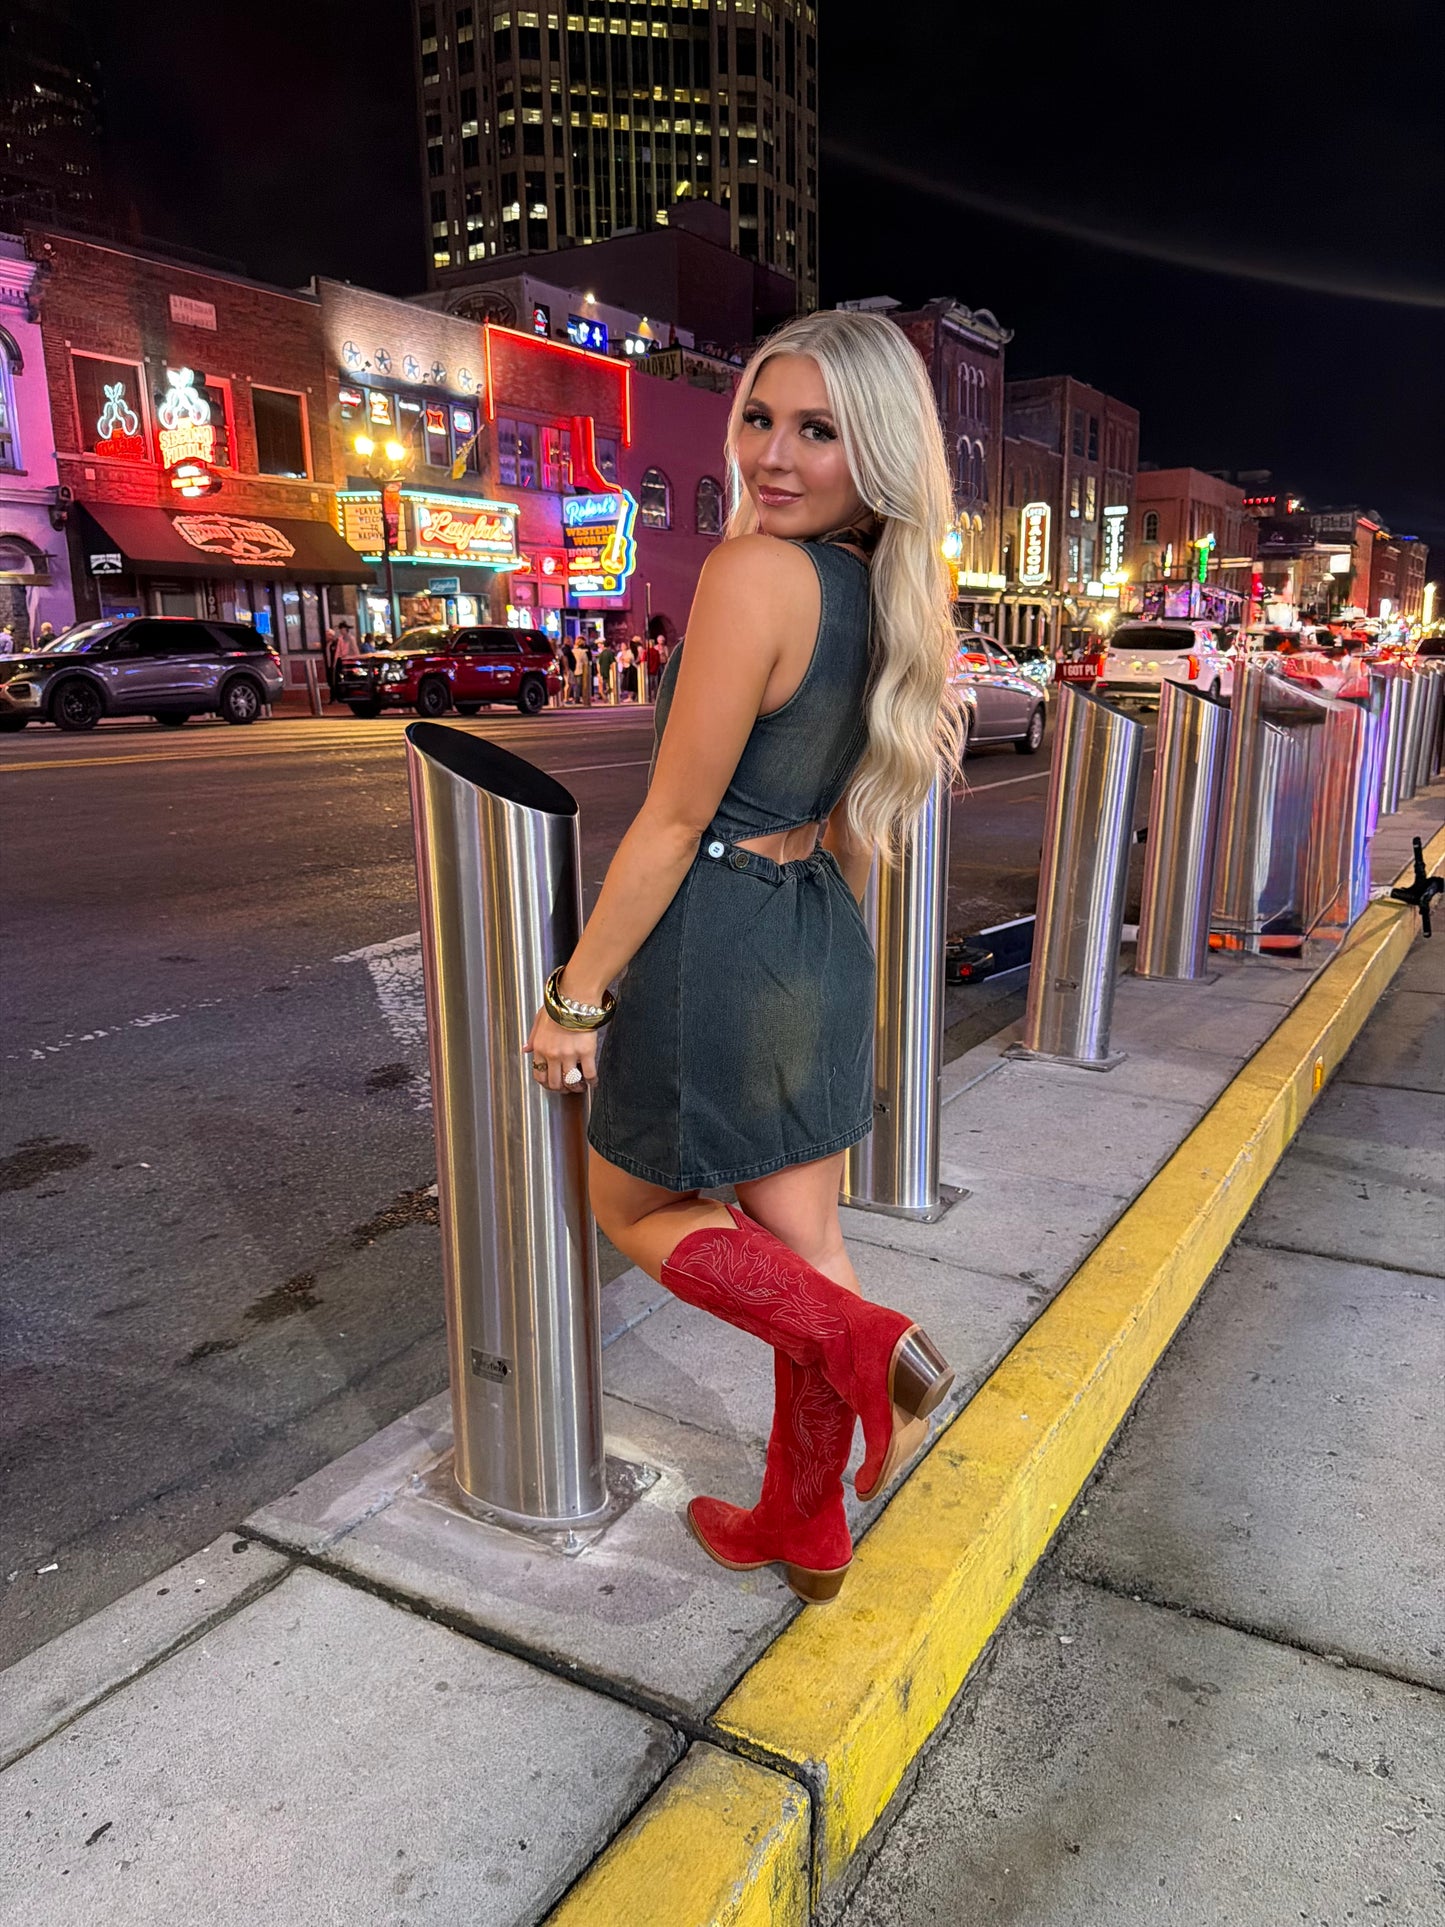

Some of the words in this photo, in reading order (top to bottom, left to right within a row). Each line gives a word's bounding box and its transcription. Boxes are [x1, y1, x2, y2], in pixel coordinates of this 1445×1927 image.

[566, 495, 617, 526] Robert's
[422, 510, 513, 551] Layla's
[565, 525, 616, 537] WESTERN
[569, 548, 598, 558] HOME
[1026, 514, 1042, 575] SALOON
[1067, 664, 1084, 676] GOT
